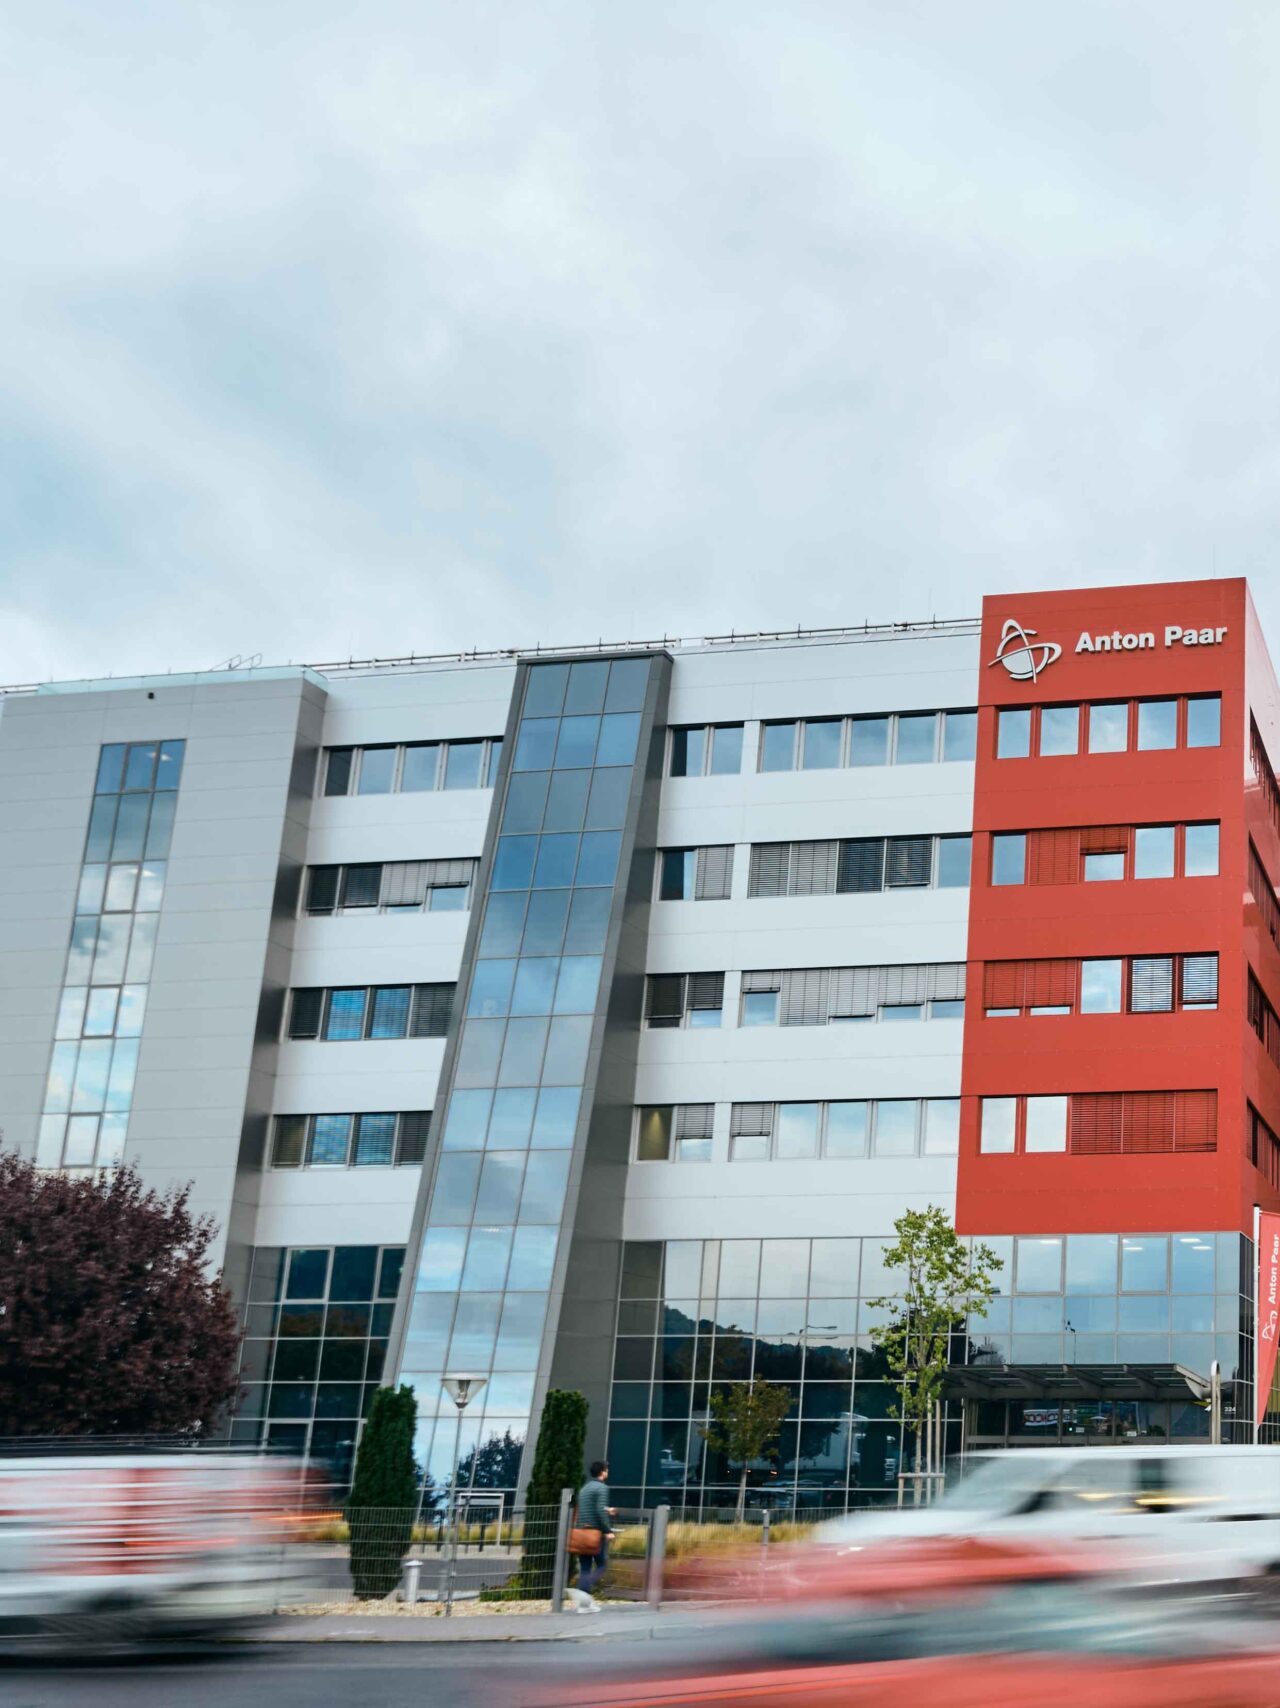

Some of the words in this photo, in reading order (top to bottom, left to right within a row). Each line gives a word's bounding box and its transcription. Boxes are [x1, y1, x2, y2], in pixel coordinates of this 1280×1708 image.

[1075, 632, 1155, 653] Anton
[1164, 626, 1227, 646] Paar
[1270, 1234, 1280, 1263] Paar
[1268, 1266, 1278, 1304] Anton
